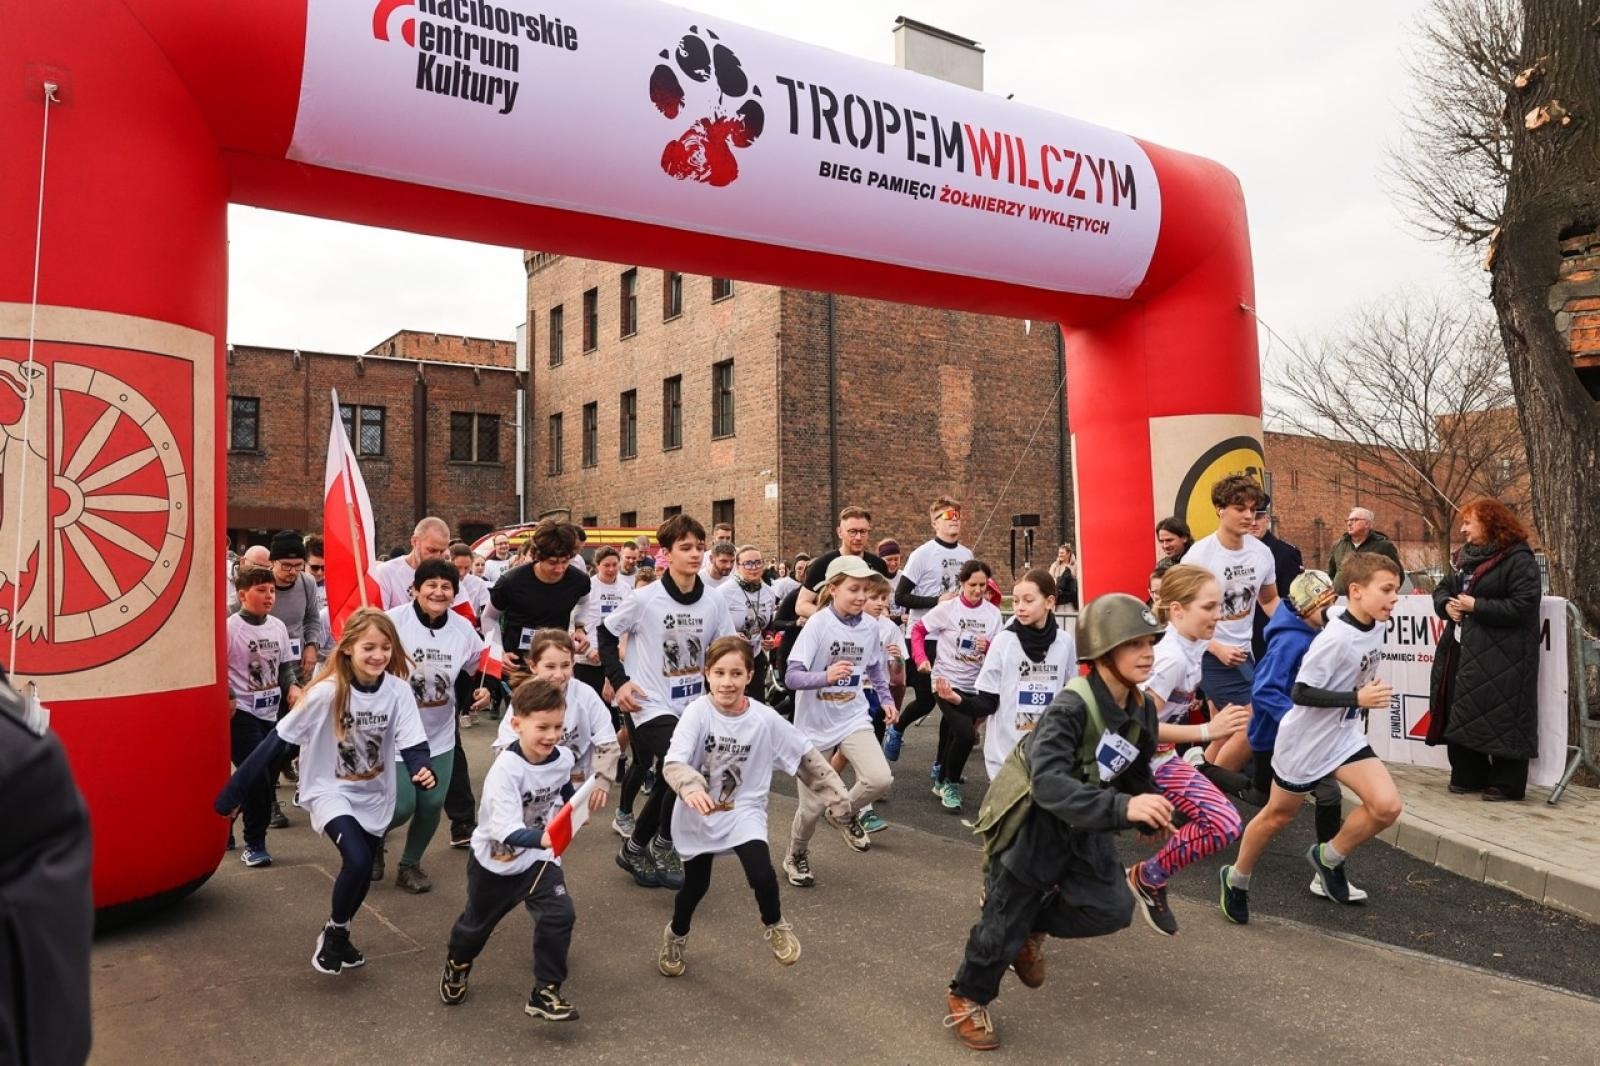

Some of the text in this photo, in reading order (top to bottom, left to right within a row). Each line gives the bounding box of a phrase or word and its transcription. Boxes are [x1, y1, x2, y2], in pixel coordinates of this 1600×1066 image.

[416, 51, 520, 115] Kultury
[819, 160, 1110, 235] BIEG PAMIĘCI ŻOŁNIERZY WYKLĘTYCH
[682, 685, 693, 697] 11
[1031, 692, 1046, 705] 89
[1390, 694, 1401, 739] FUNDACJA
[1110, 755, 1126, 772] 48
